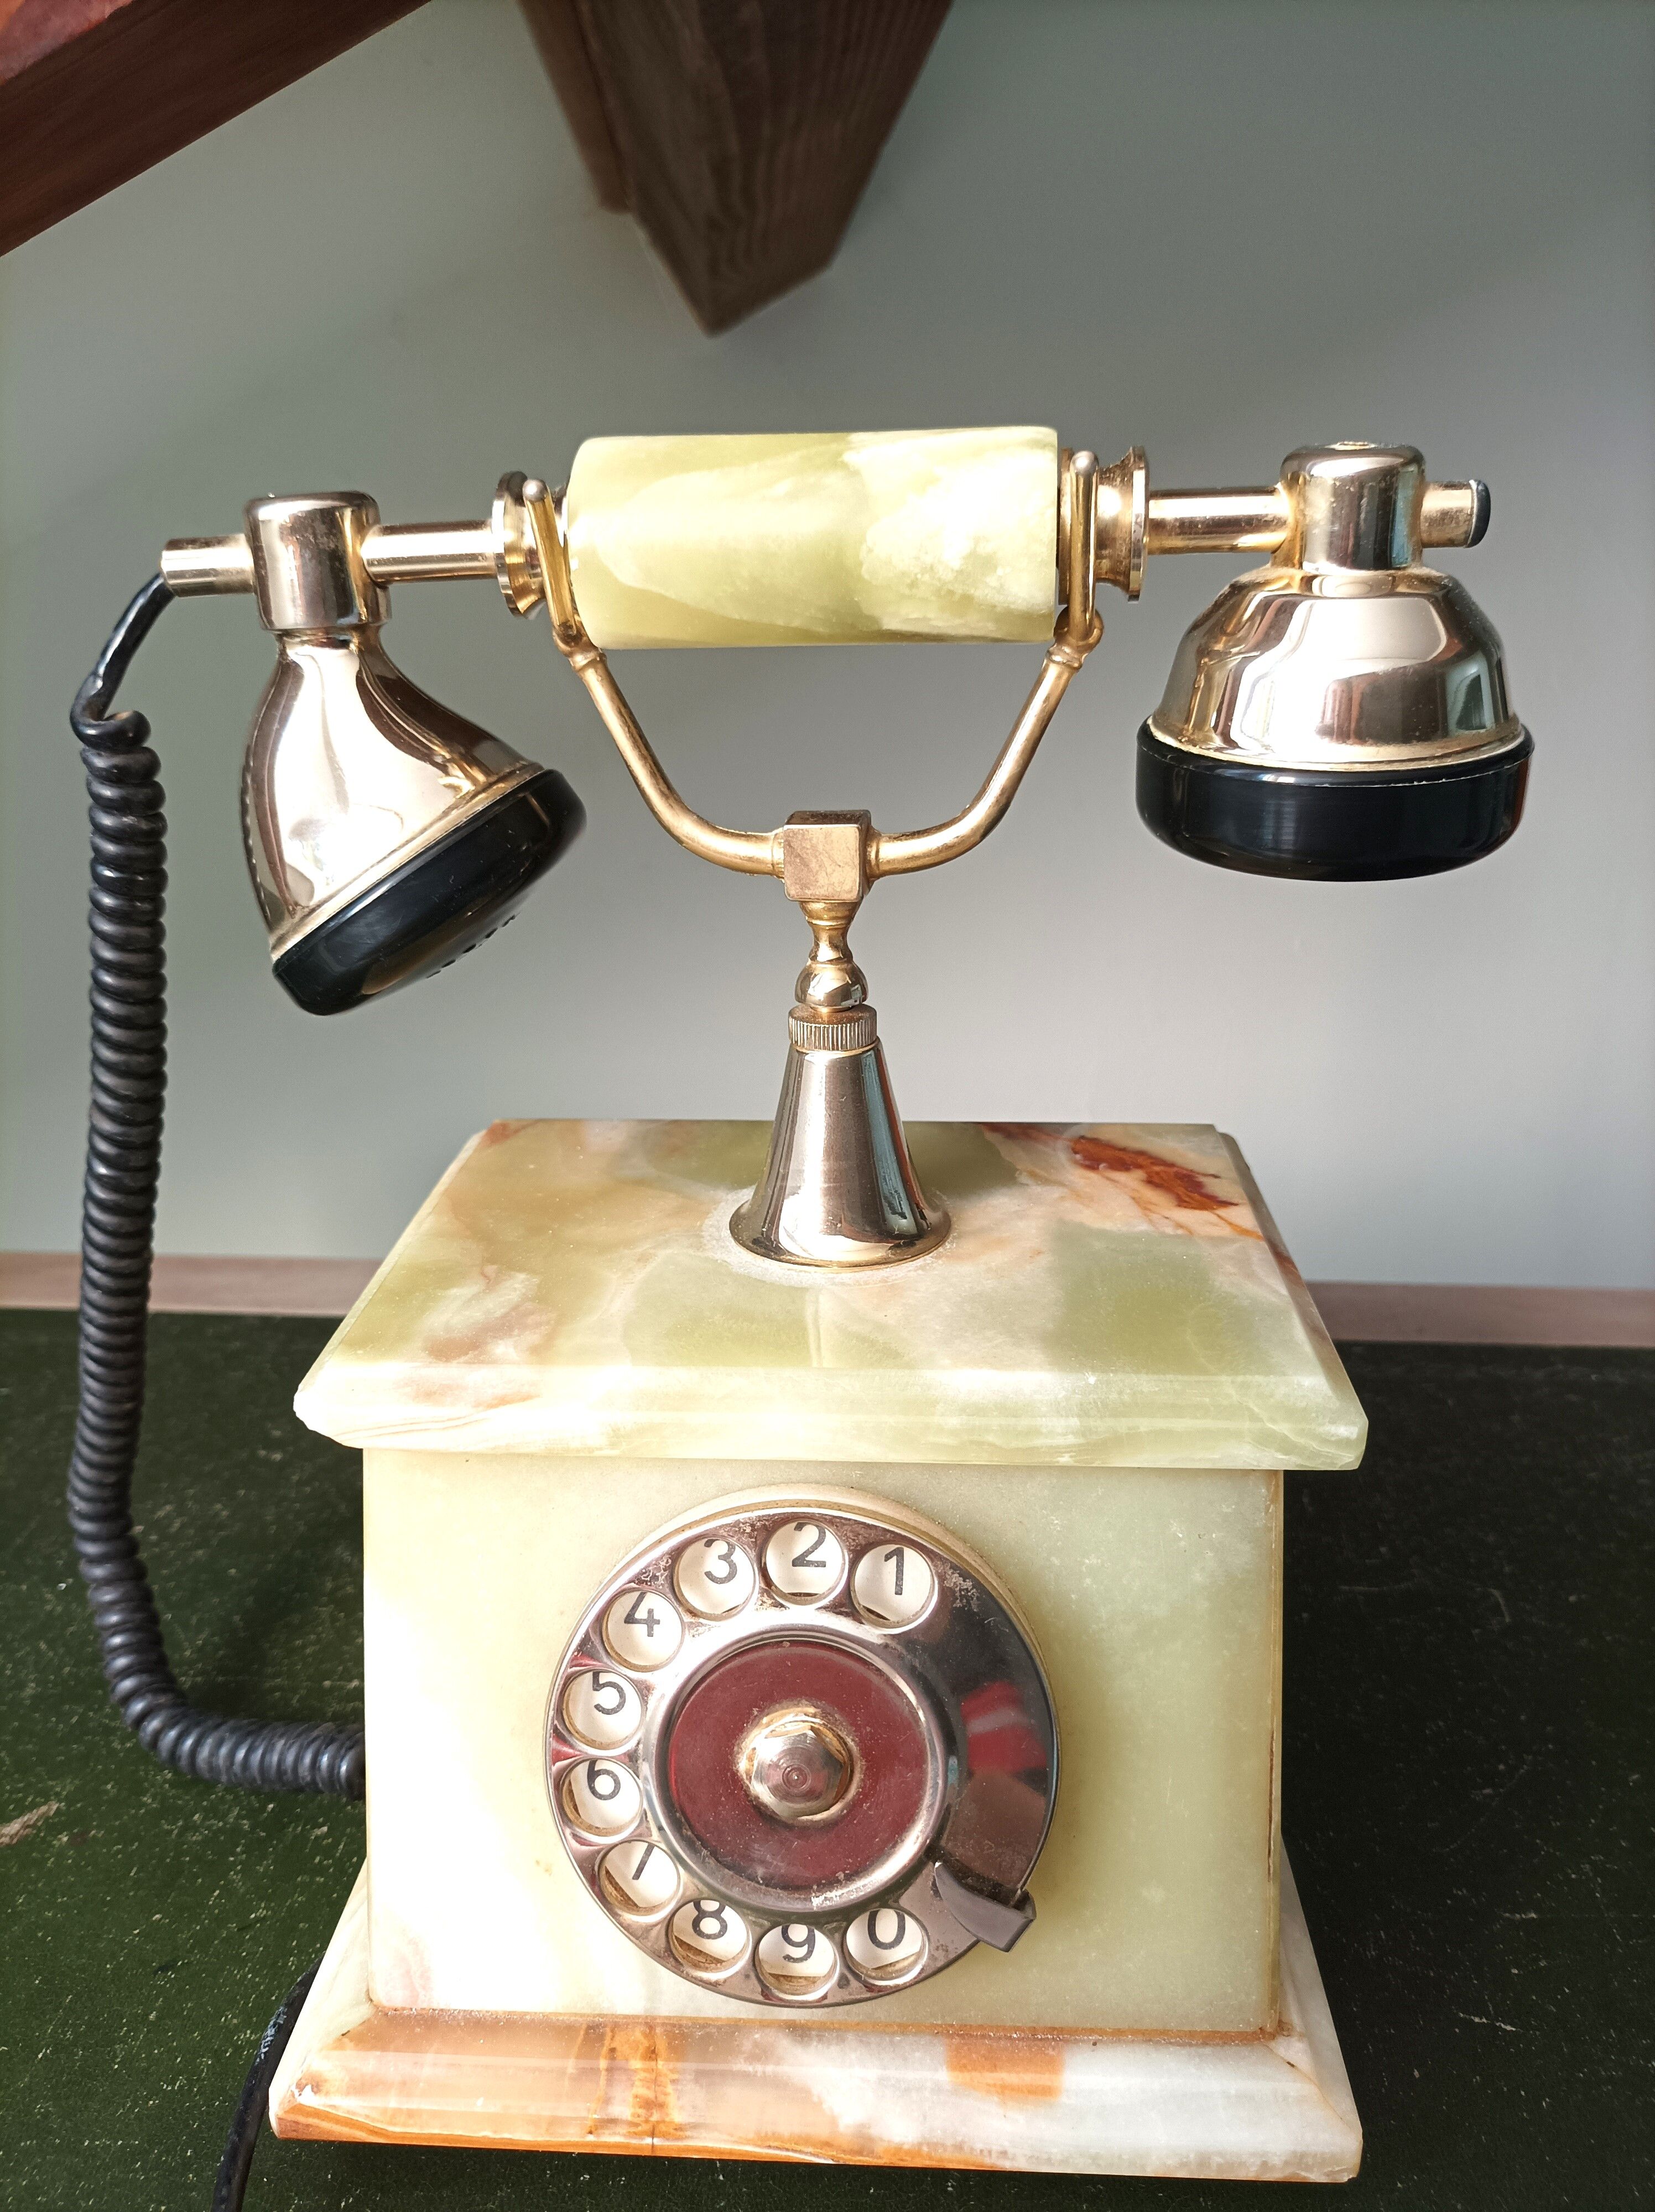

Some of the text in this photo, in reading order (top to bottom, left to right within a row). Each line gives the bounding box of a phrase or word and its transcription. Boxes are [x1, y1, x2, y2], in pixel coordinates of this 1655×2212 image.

[704, 1538, 737, 1584] 3
[792, 1522, 826, 1567] 2
[884, 1546, 904, 1595] 1
[624, 1592, 660, 1637] 4
[592, 1672, 626, 1715] 5
[587, 1760, 621, 1801] 6
[692, 1900, 728, 1939] 8
[782, 1924, 815, 1963] 9
